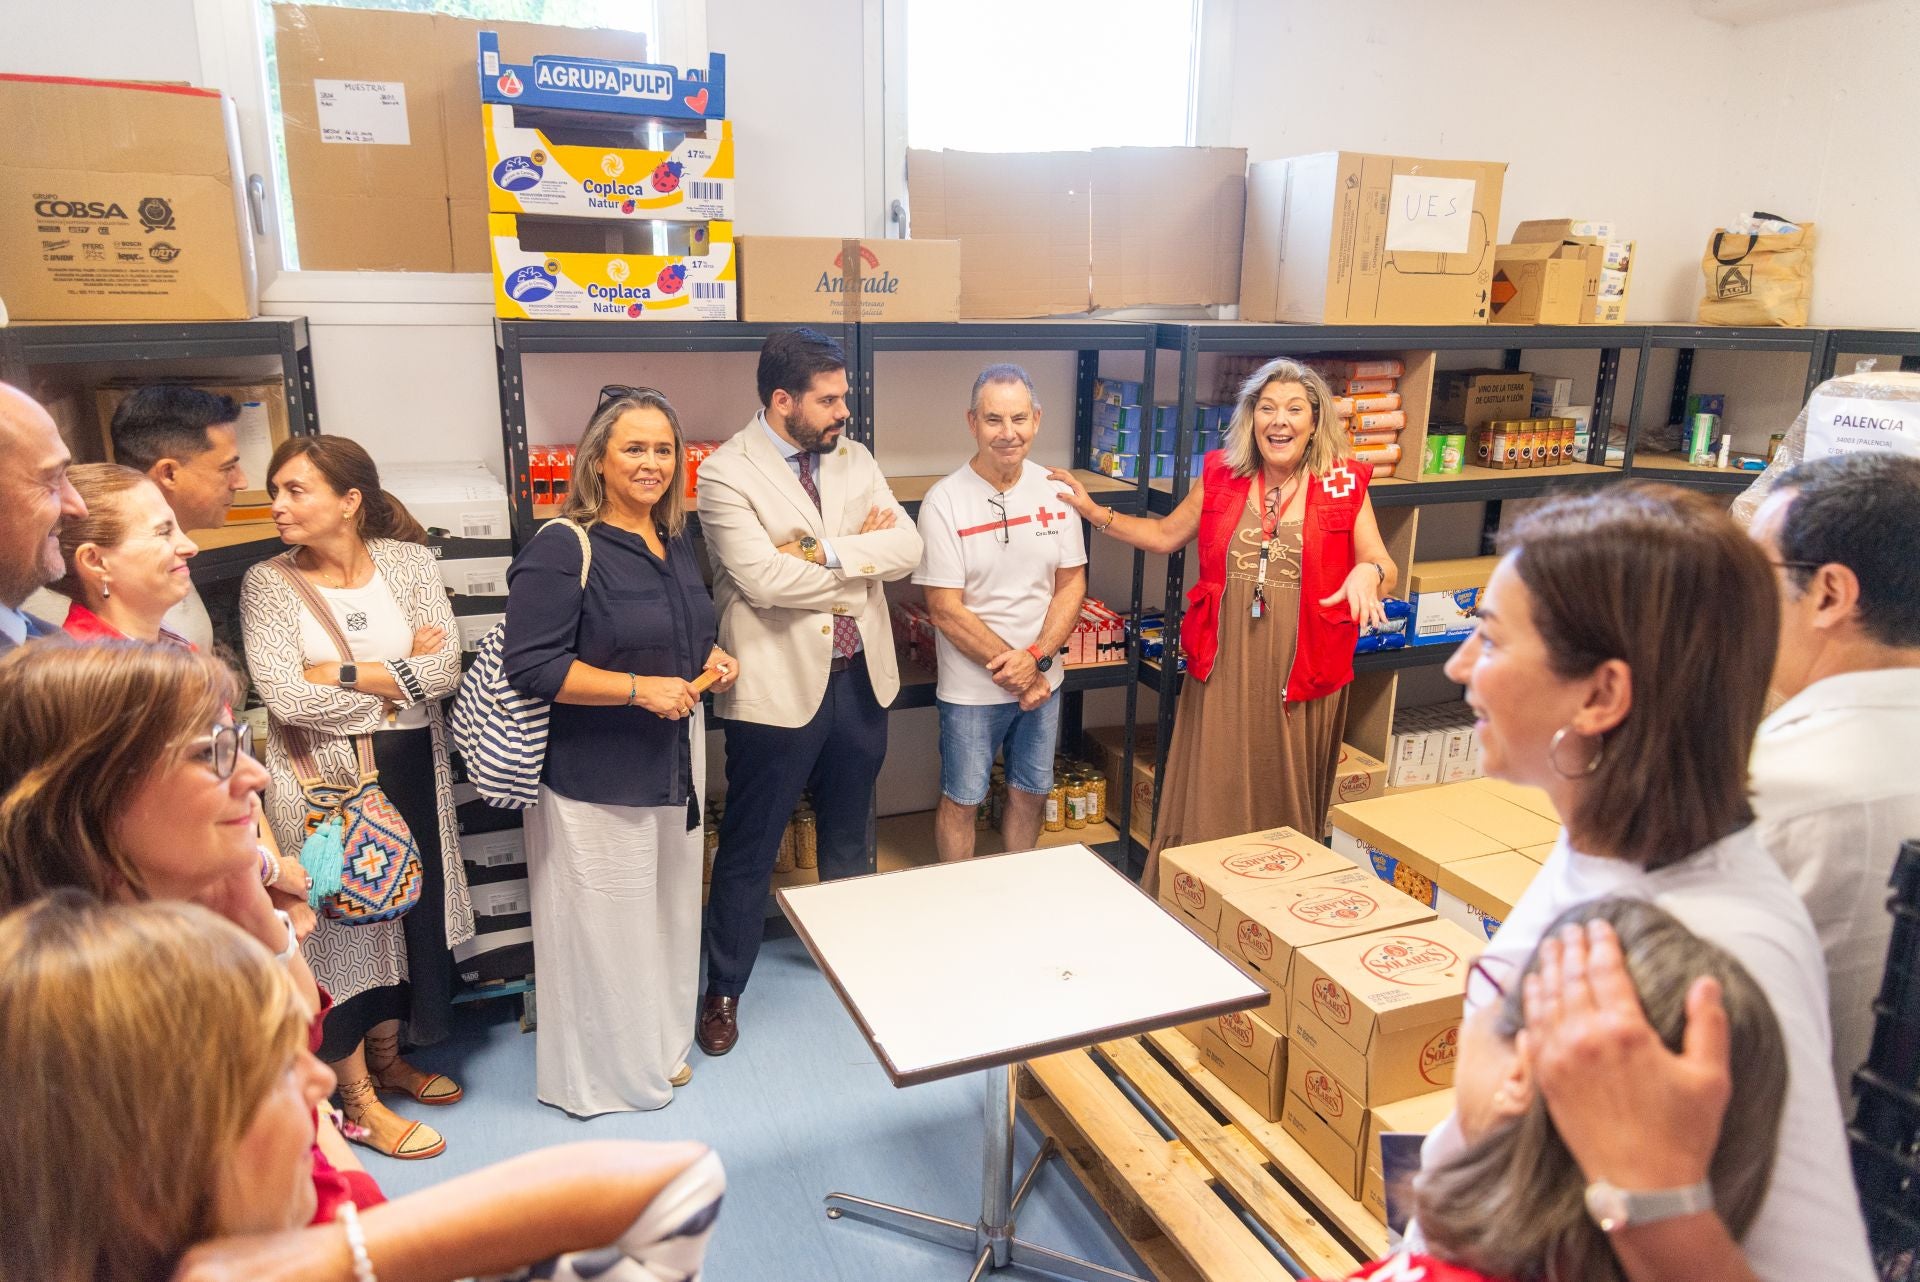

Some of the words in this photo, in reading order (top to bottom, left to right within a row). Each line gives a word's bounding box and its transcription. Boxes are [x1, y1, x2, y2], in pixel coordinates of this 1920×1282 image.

[344, 83, 386, 92] MUESTRAS
[538, 65, 671, 95] AGRUPAPULPI
[688, 150, 698, 158] 17
[583, 180, 643, 197] Coplaca
[35, 200, 128, 219] COBSA
[588, 197, 619, 208] Natur
[1406, 194, 1456, 221] UES
[692, 260, 702, 268] 17
[587, 283, 650, 301] Coplaca
[593, 302, 626, 313] Natur
[1479, 385, 1491, 393] VINO
[1492, 384, 1499, 392] DE
[1508, 383, 1524, 391] TIERRA
[1475, 396, 1482, 404] DE
[1483, 395, 1505, 403] CASTILLA
[1833, 414, 1904, 431] PALENCIA
[1857, 439, 1893, 448] (PALENCIA)
[1340, 782, 1367, 793] SOLARES
[1231, 850, 1297, 871] SOLARES
[1176, 878, 1202, 905] SOLARES
[1299, 896, 1371, 918] SOLARES
[1240, 926, 1268, 956] SOLARES
[1369, 948, 1447, 974] SOLARES
[1315, 983, 1347, 1019] SOLARES
[1424, 1047, 1458, 1066] SOLA
[1307, 1076, 1339, 1113] SOLARES
